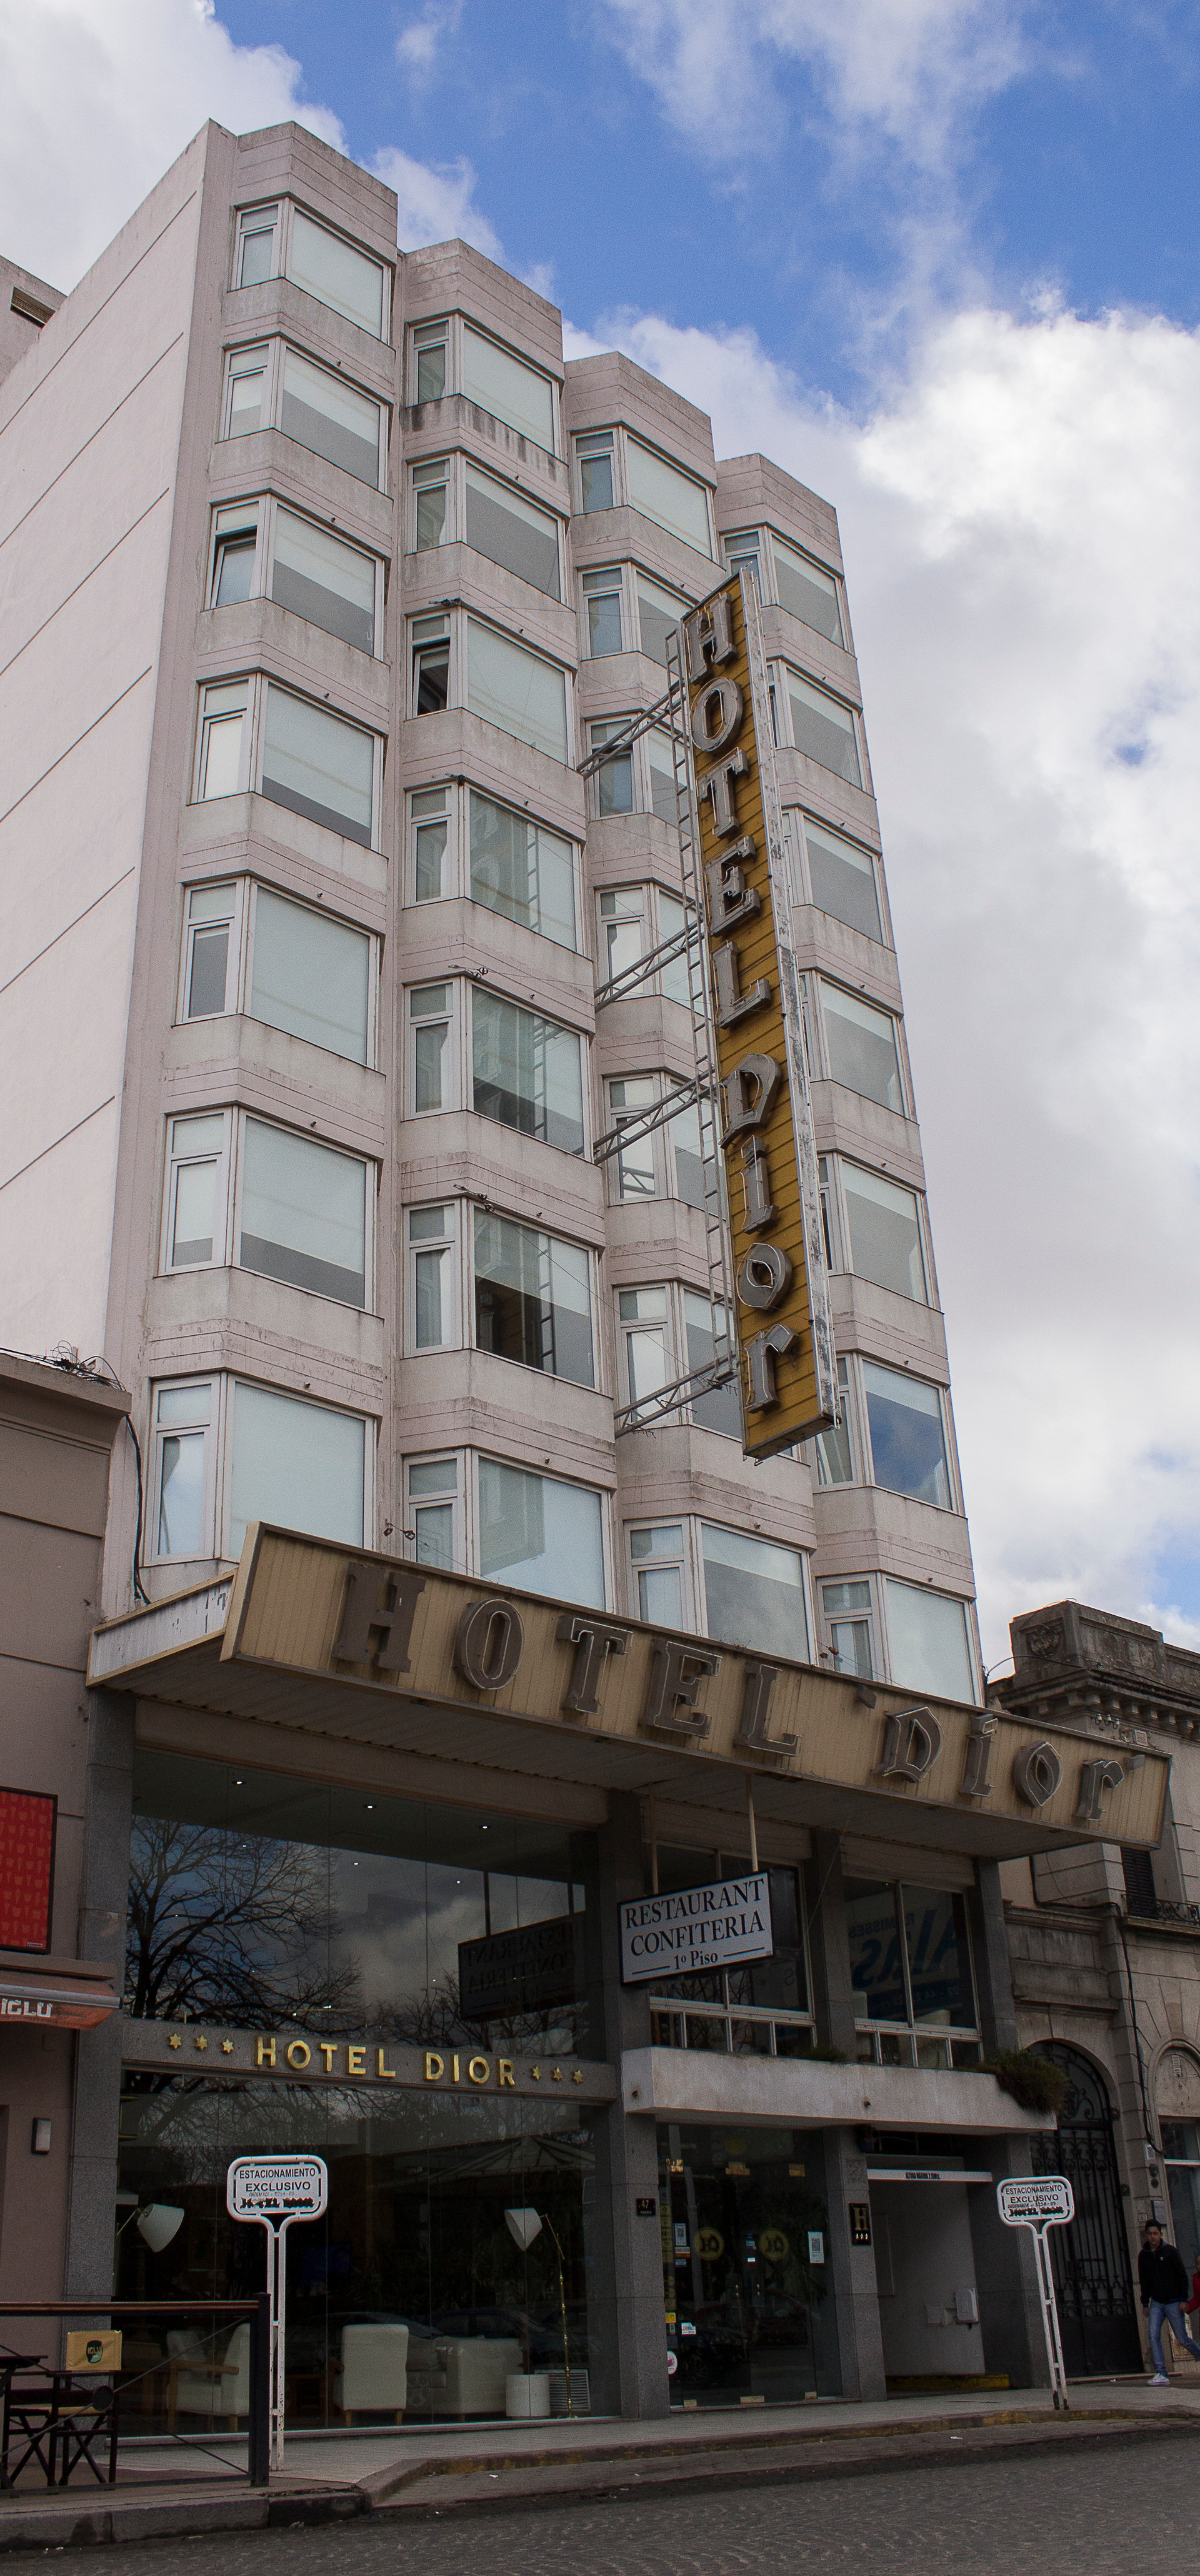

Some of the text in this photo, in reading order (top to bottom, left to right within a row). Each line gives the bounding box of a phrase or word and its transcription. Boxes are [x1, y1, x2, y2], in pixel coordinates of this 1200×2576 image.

[688, 591, 799, 1414] HOTEL Dior
[331, 1563, 802, 1757] HOTEL
[626, 1877, 764, 1929] RESTAURANT
[631, 1910, 765, 1956] CONFITERIA
[690, 1950, 718, 1967] Piso
[257, 2036, 516, 2086] HOTEL DIOR
[239, 2168, 316, 2179] ESTACIONAMIENTO
[246, 2182, 311, 2192] EXCLUSIVO
[1006, 2185, 1062, 2195] ESTACIONAMIENTO
[1011, 2194, 1059, 2203] EXCLUSIVO
[854, 2207, 869, 2230] H
